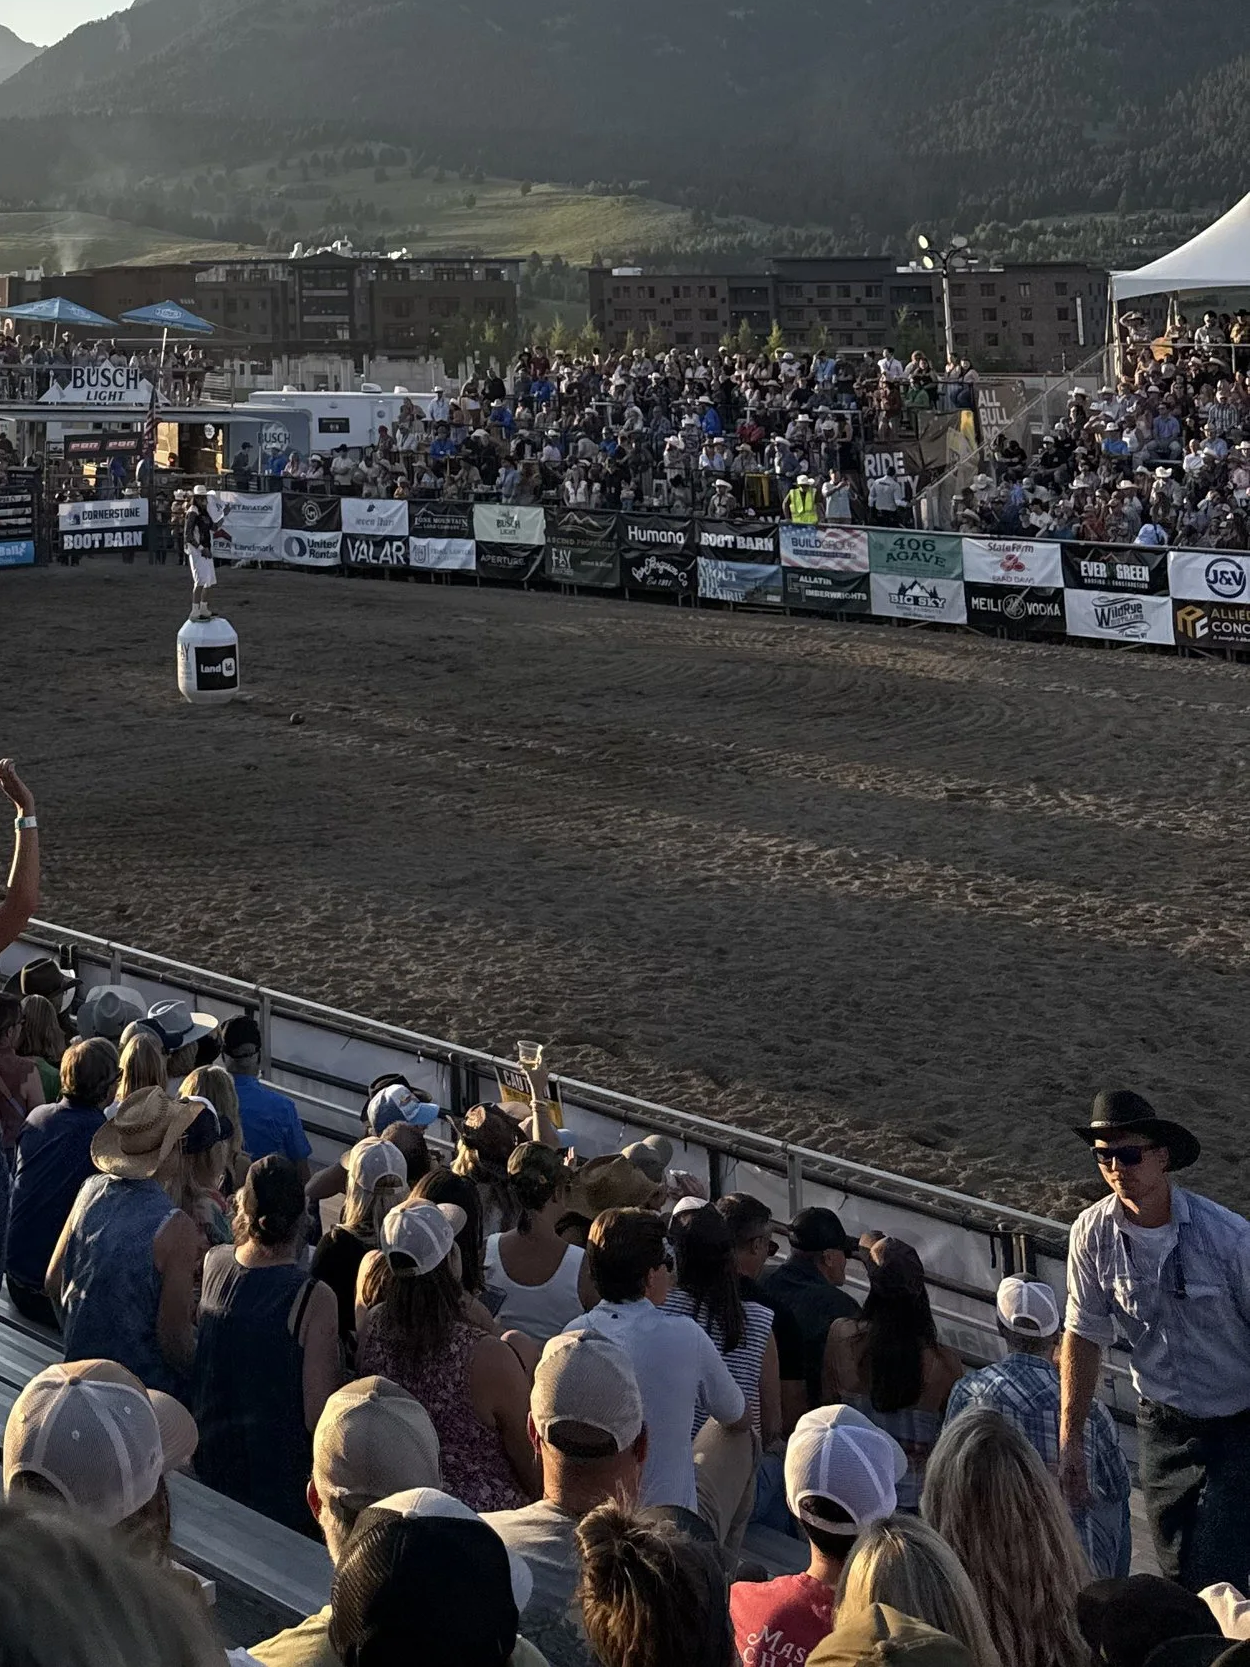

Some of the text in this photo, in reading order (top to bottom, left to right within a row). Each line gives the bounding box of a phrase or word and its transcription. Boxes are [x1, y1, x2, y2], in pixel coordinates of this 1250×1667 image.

[72, 367, 139, 390] BUSCH
[86, 390, 125, 401] LIGHT
[978, 389, 1000, 406] ALL
[108, 440, 136, 448] PBR
[257, 432, 291, 444] BUSCH
[71, 442, 99, 450] PBR
[864, 452, 905, 476] RIDE
[82, 507, 141, 521] CORNERSTONE
[433, 517, 468, 527] MOUNTAIN
[496, 519, 521, 529] BUSCH
[63, 531, 145, 550] BOOT BARN
[627, 525, 685, 545] Humana
[700, 532, 774, 552] BOOT BARN
[213, 540, 231, 549] ERA
[234, 543, 275, 552] Landmark
[307, 538, 339, 548] United
[791, 537, 857, 550] BUILDGROUP
[893, 537, 936, 552] 406
[347, 537, 406, 565] VALAR
[551, 547, 570, 569] FAY
[480, 554, 525, 566] APERTURE
[886, 551, 946, 568] AGAVE
[1206, 569, 1245, 586] J&V
[889, 594, 946, 609] BIG SKY
[971, 596, 1061, 617] MEILI VODKA
